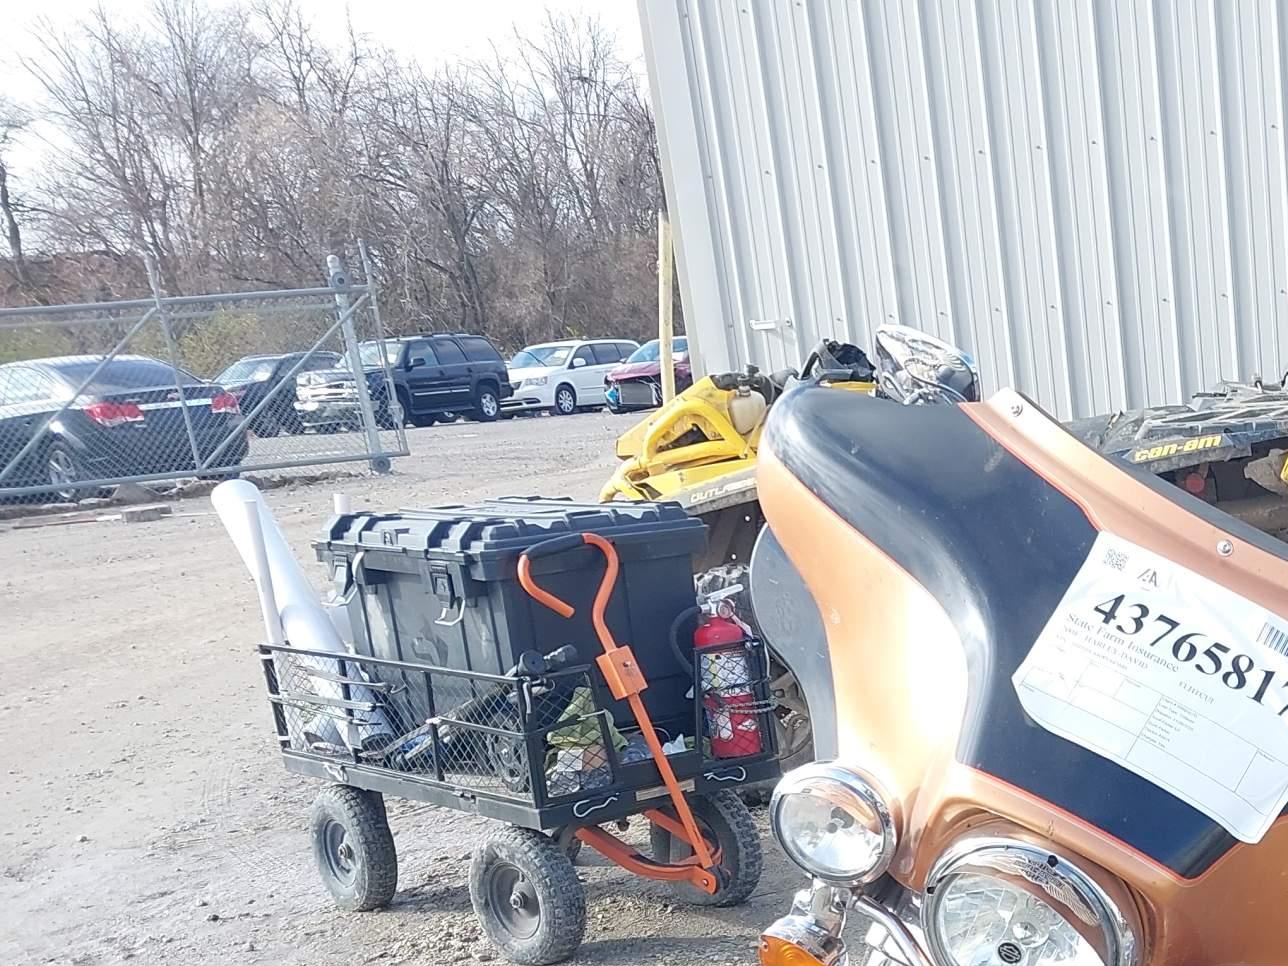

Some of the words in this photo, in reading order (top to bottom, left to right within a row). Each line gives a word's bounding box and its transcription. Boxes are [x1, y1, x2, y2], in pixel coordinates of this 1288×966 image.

[1134, 435, 1222, 462] can-am
[1067, 612, 1095, 632] State
[1096, 625, 1125, 646] Farm
[1127, 641, 1180, 673] Insurance
